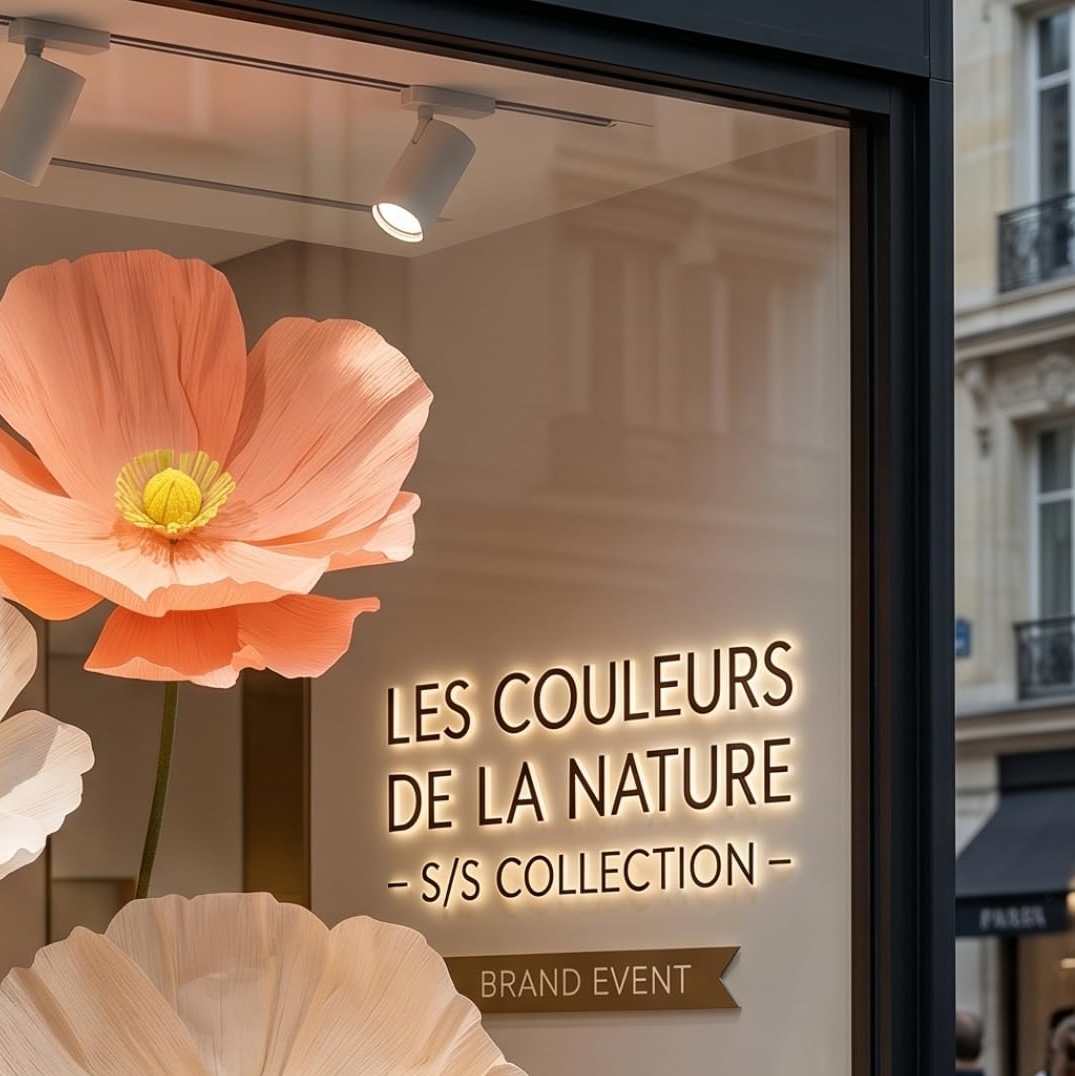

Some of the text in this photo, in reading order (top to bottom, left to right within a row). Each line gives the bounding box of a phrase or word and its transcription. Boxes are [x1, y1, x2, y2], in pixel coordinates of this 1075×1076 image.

[387, 640, 794, 746] LES COULEURS
[388, 738, 790, 832] DE LA NATURE
[422, 858, 479, 907] S/S
[497, 843, 753, 898] COLLECTION
[480, 964, 692, 998] BRAND EVENT
